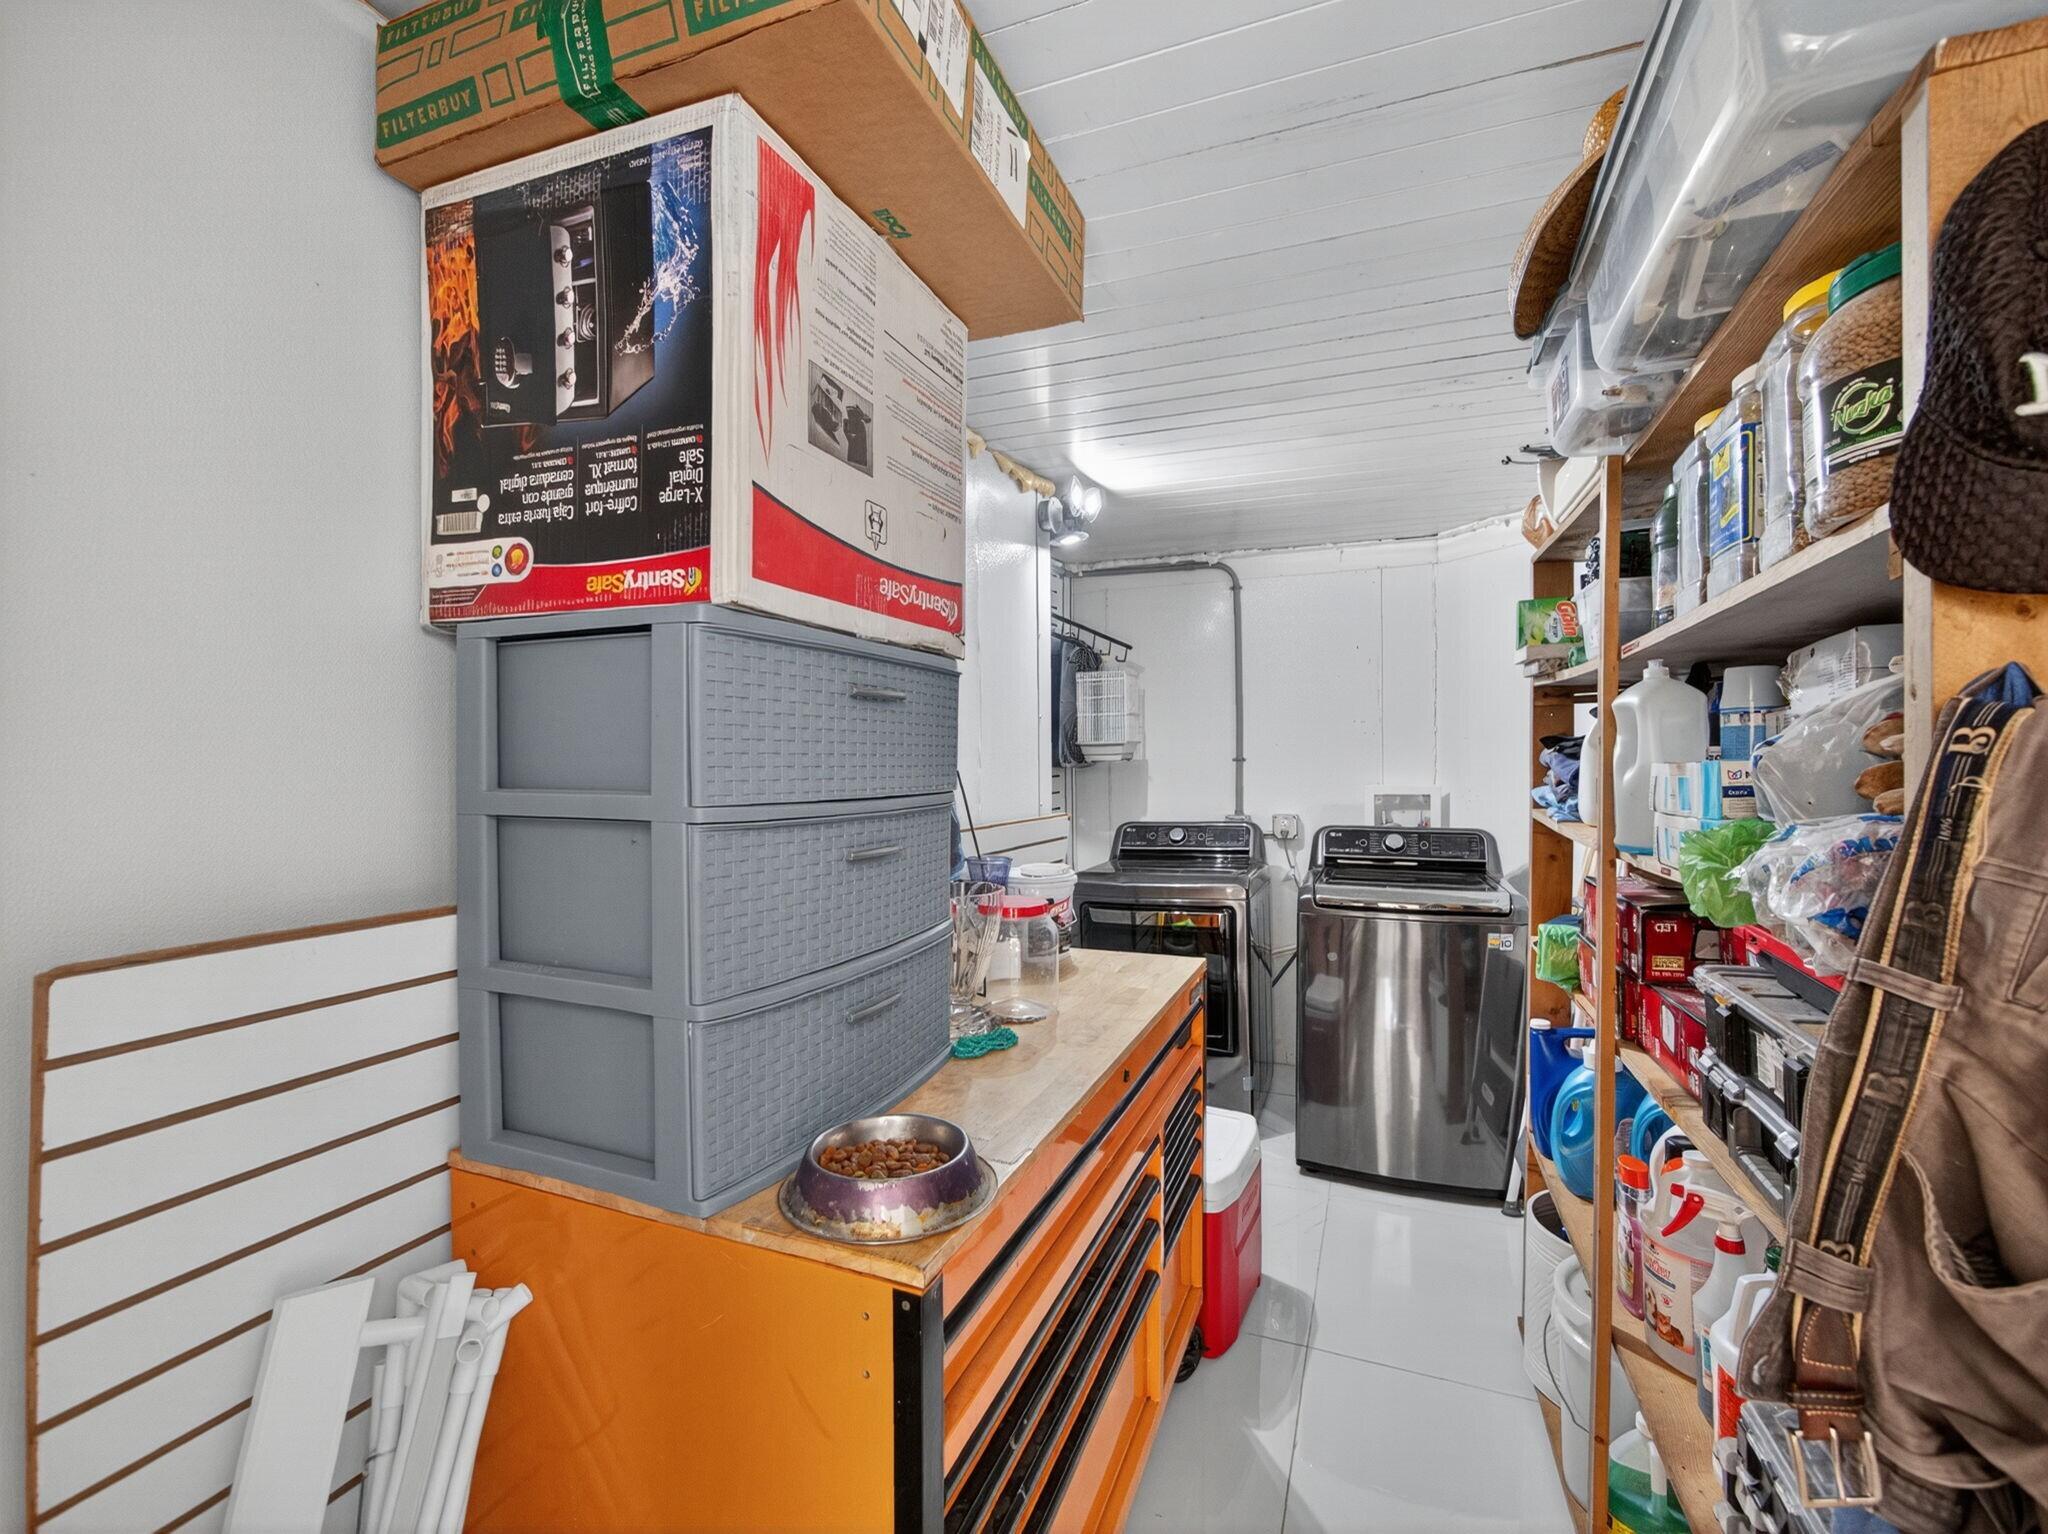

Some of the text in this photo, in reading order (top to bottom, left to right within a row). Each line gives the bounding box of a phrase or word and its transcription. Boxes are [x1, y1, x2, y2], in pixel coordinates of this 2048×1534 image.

[381, 87, 471, 139] FILTERBUY
[588, 457, 638, 479] format XL
[678, 448, 704, 467] Safe
[499, 469, 574, 494] cerradura digital
[584, 477, 638, 497] numérique
[669, 465, 703, 488] Digital
[522, 484, 574, 505] grande con
[585, 495, 638, 516] Coffre-fort
[659, 486, 703, 504] X-Large
[498, 503, 574, 526] Caja fuerte extra
[586, 568, 686, 594] SentrySafe
[879, 577, 950, 617] SentrySafe
[1556, 600, 1578, 637] Gain
[1948, 726, 1997, 756] B
[1654, 923, 1678, 933] LED
[1501, 940, 1512, 948] 10
[1862, 1071, 1909, 1098] B
